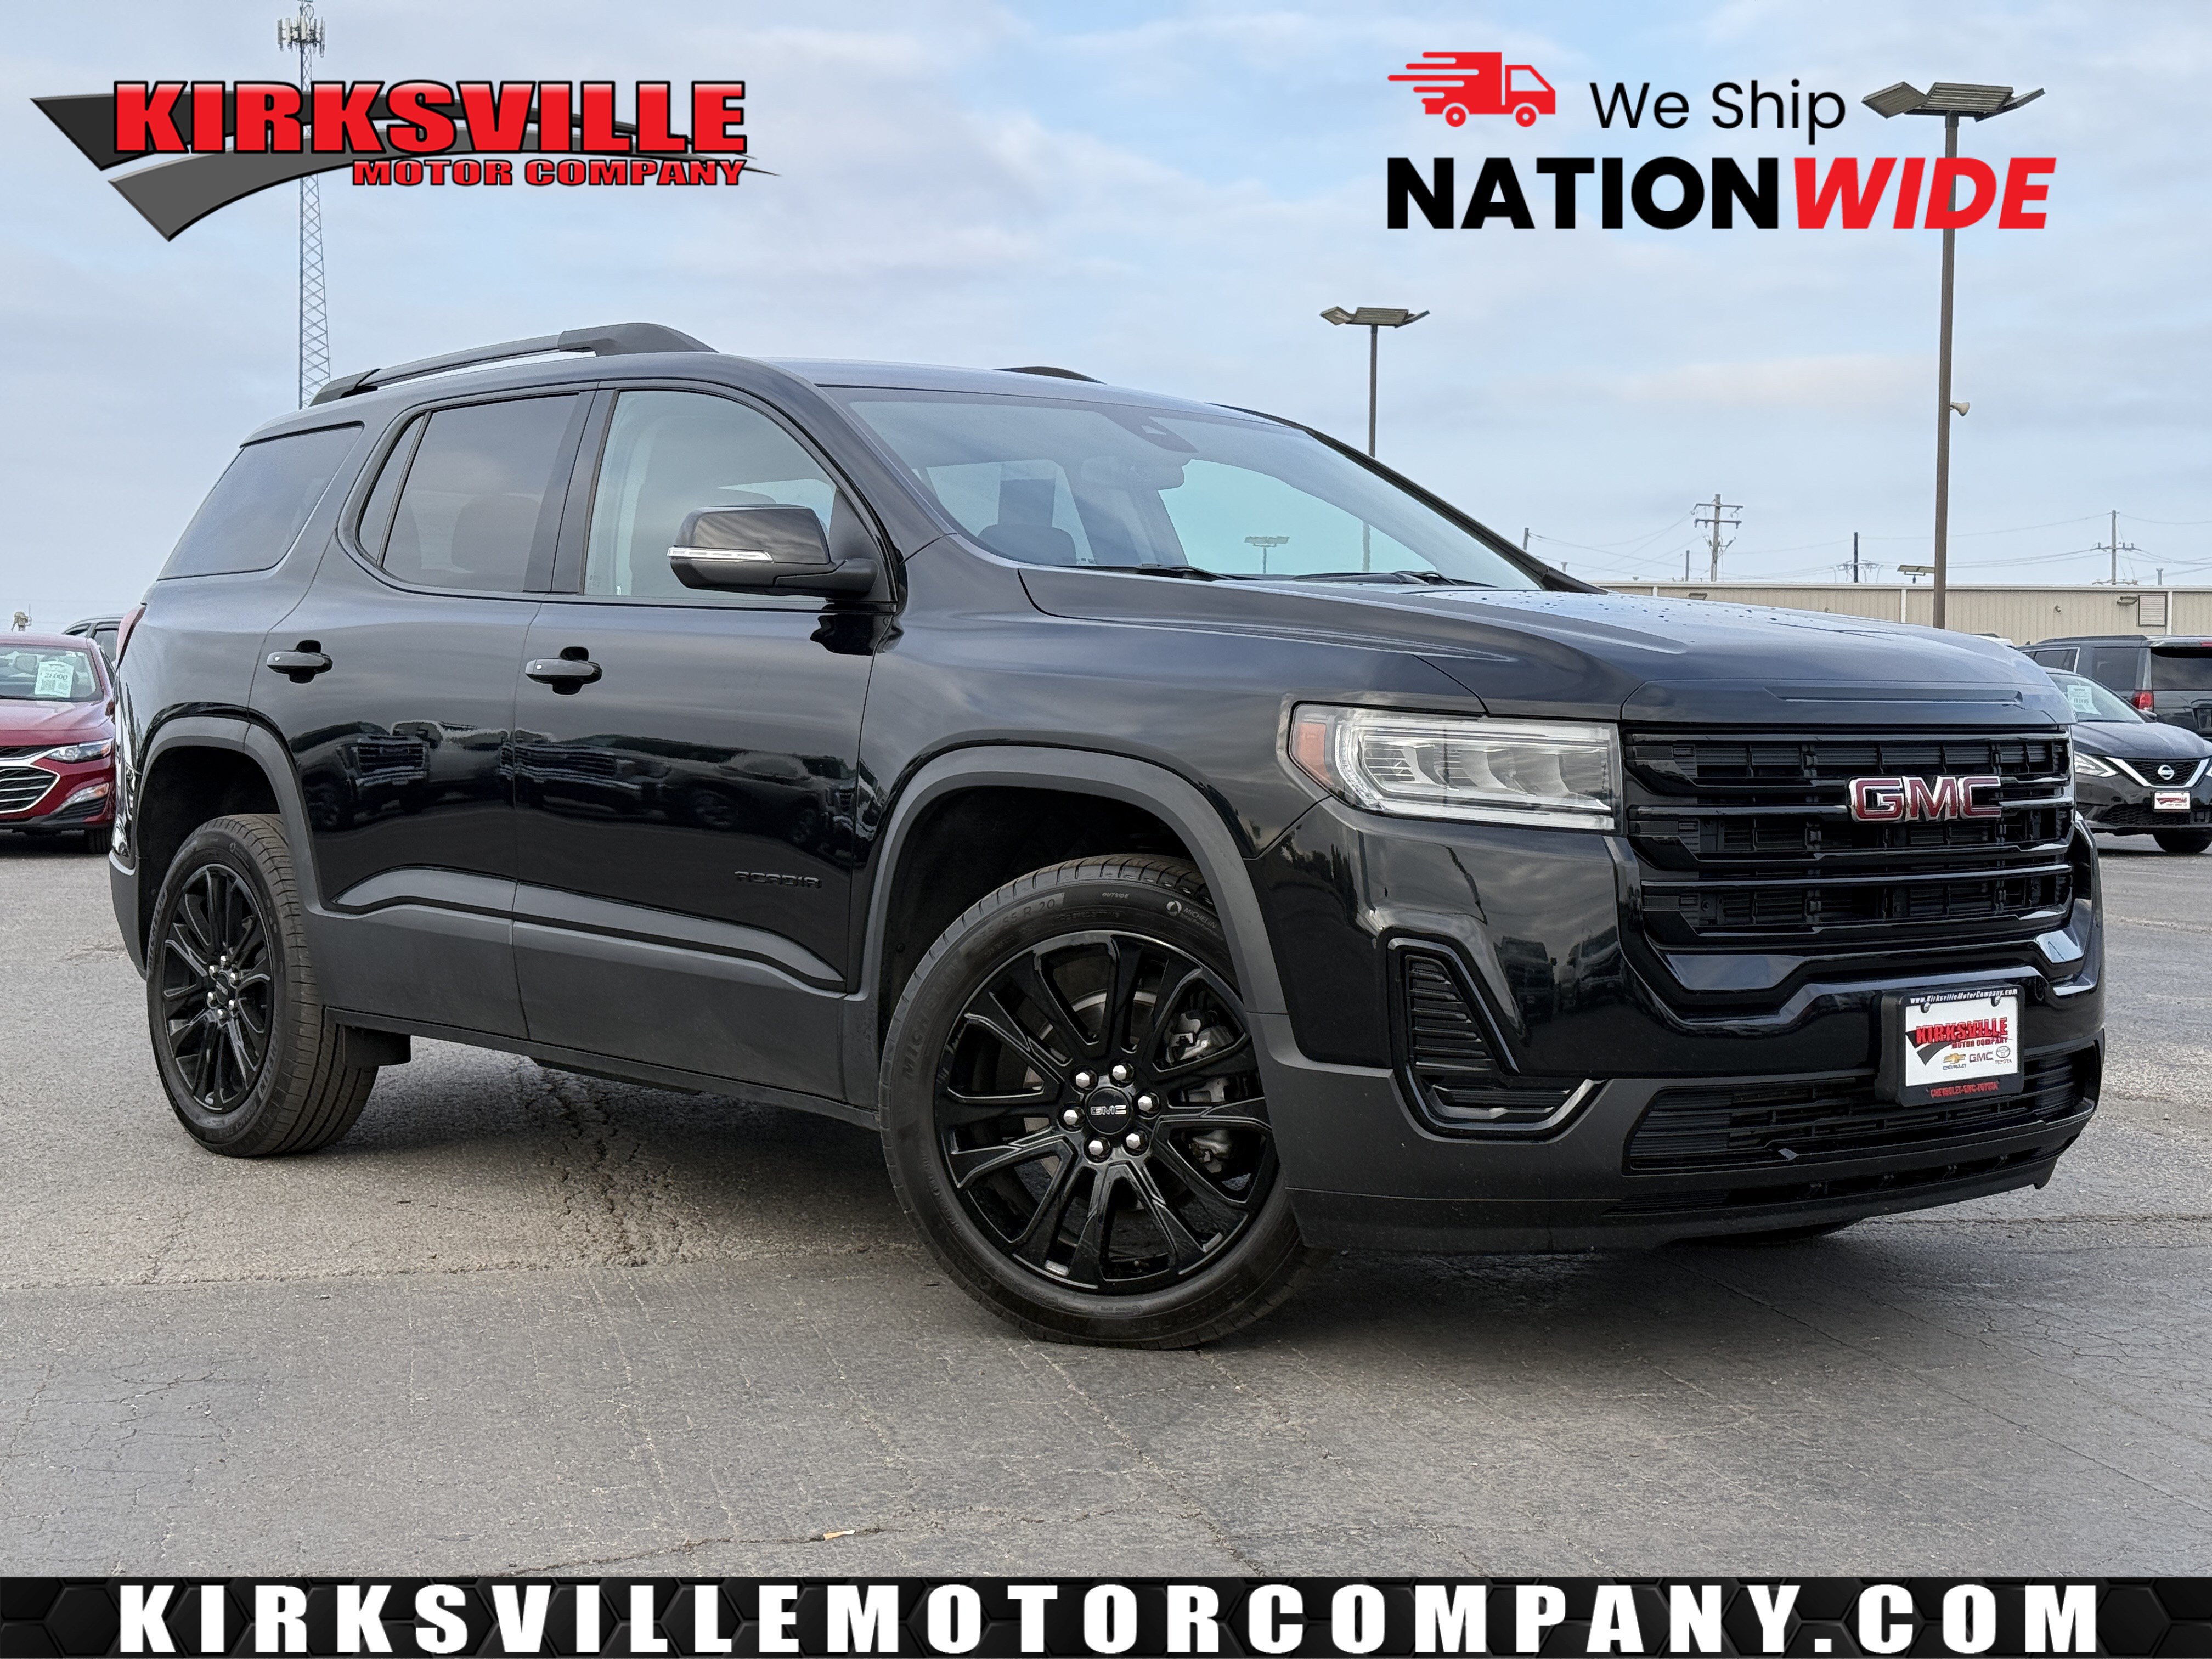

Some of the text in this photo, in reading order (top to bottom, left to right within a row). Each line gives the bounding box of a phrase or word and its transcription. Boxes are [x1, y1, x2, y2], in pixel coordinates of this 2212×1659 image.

[1849, 776, 2001, 822] GMC
[1183, 907, 1218, 929] MICHELIN
[1916, 1017, 2008, 1044] KIRKSVILLE
[1951, 1036, 2008, 1049] MOTOR COMPANY
[1969, 1051, 1994, 1063] GMC
[1090, 1104, 1127, 1116] GMC
